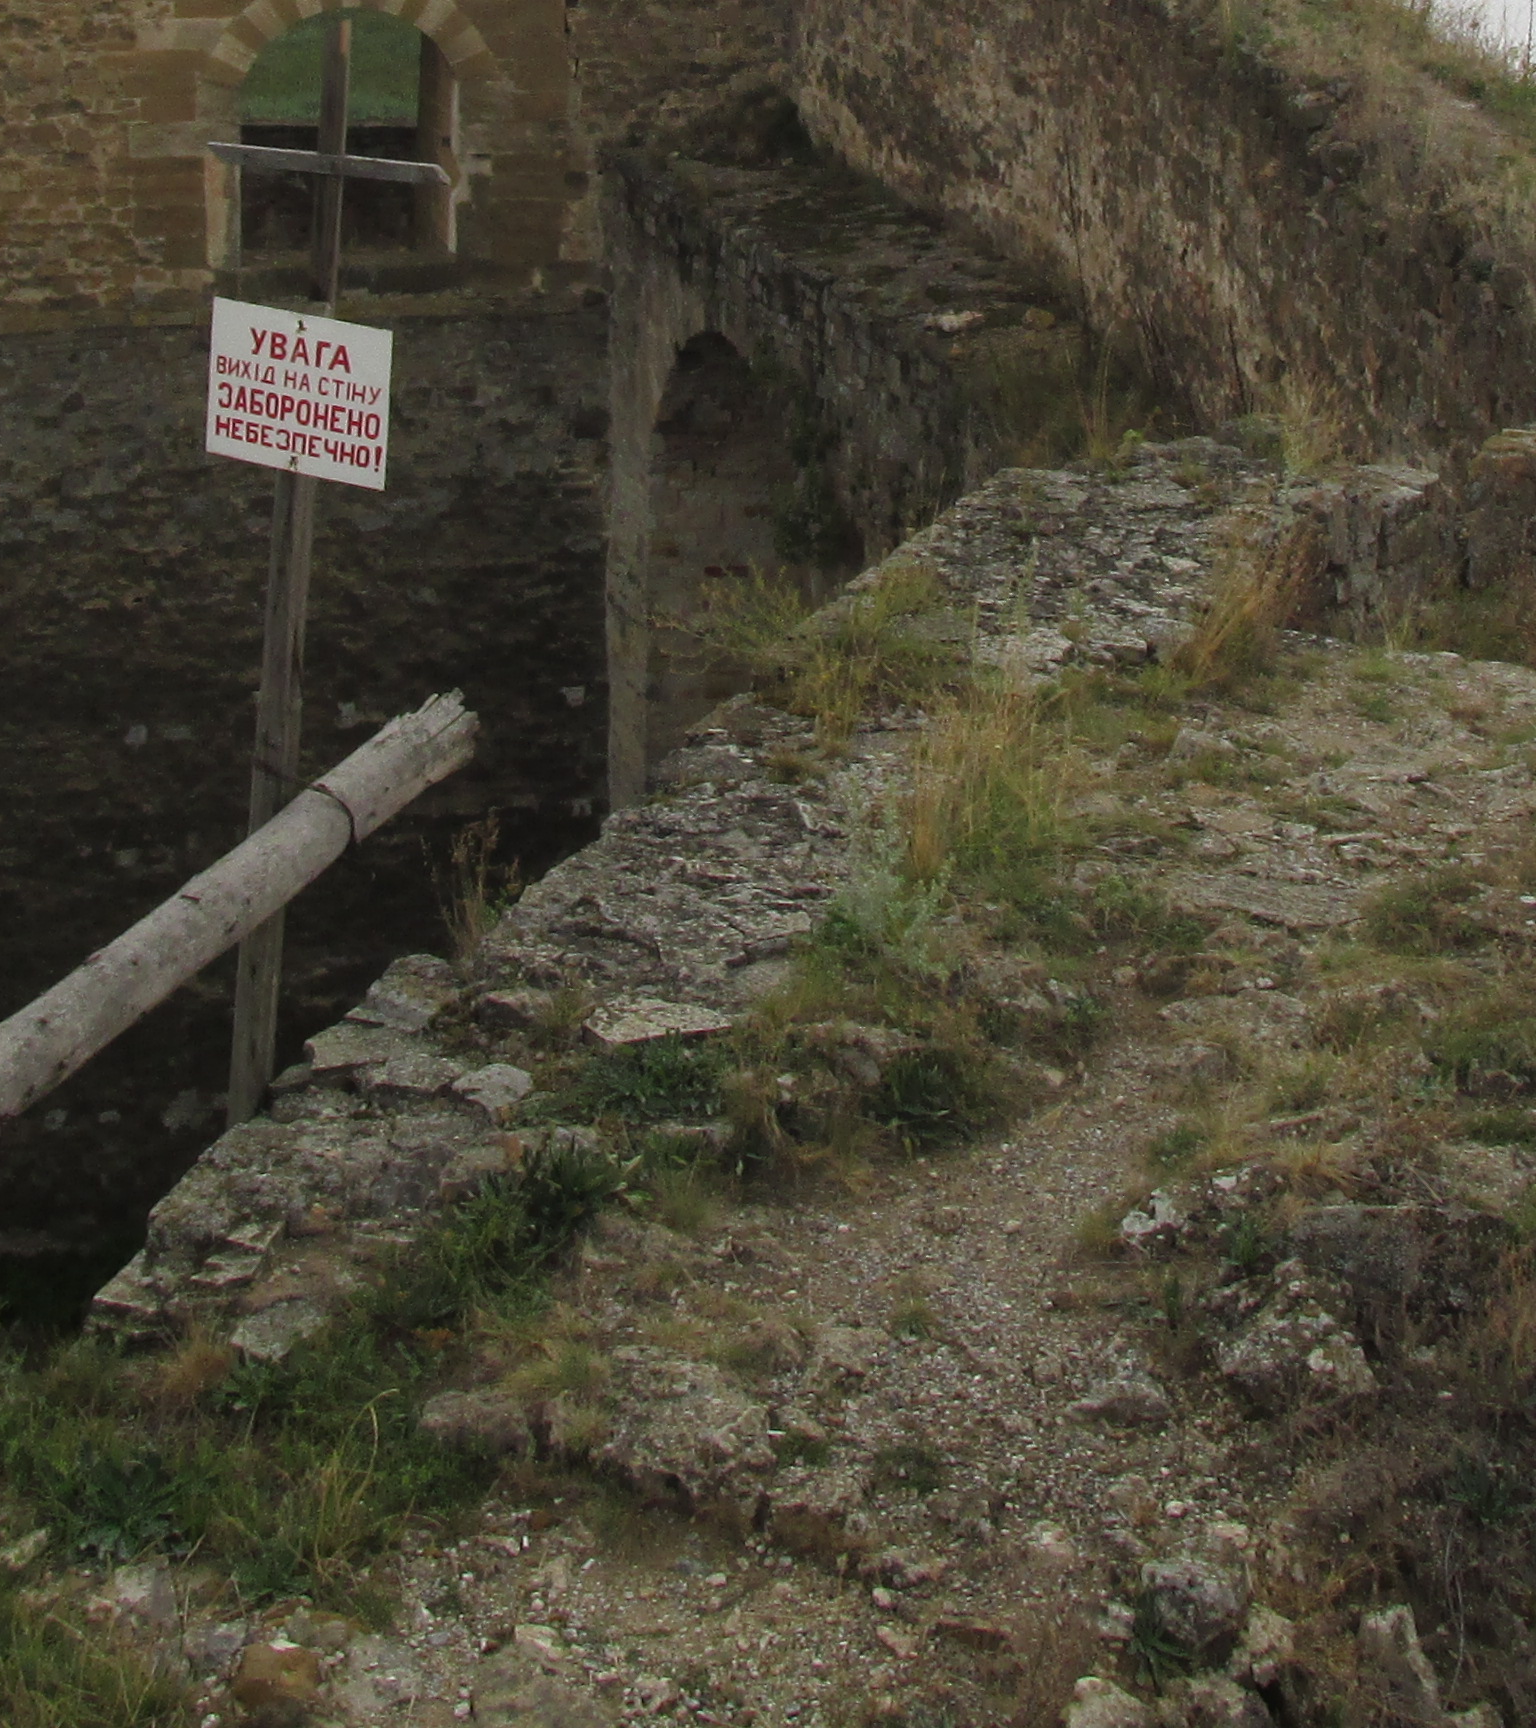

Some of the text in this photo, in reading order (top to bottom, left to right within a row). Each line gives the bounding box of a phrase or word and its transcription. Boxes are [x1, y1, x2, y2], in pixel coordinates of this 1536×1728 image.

[249, 327, 352, 374] УВАГА
[216, 355, 382, 405] ВИХІД НА СТІНУ
[217, 381, 381, 440] ЗАБОРОНЕНО
[215, 414, 383, 473] НЕБЕЗПЕЧНО!
